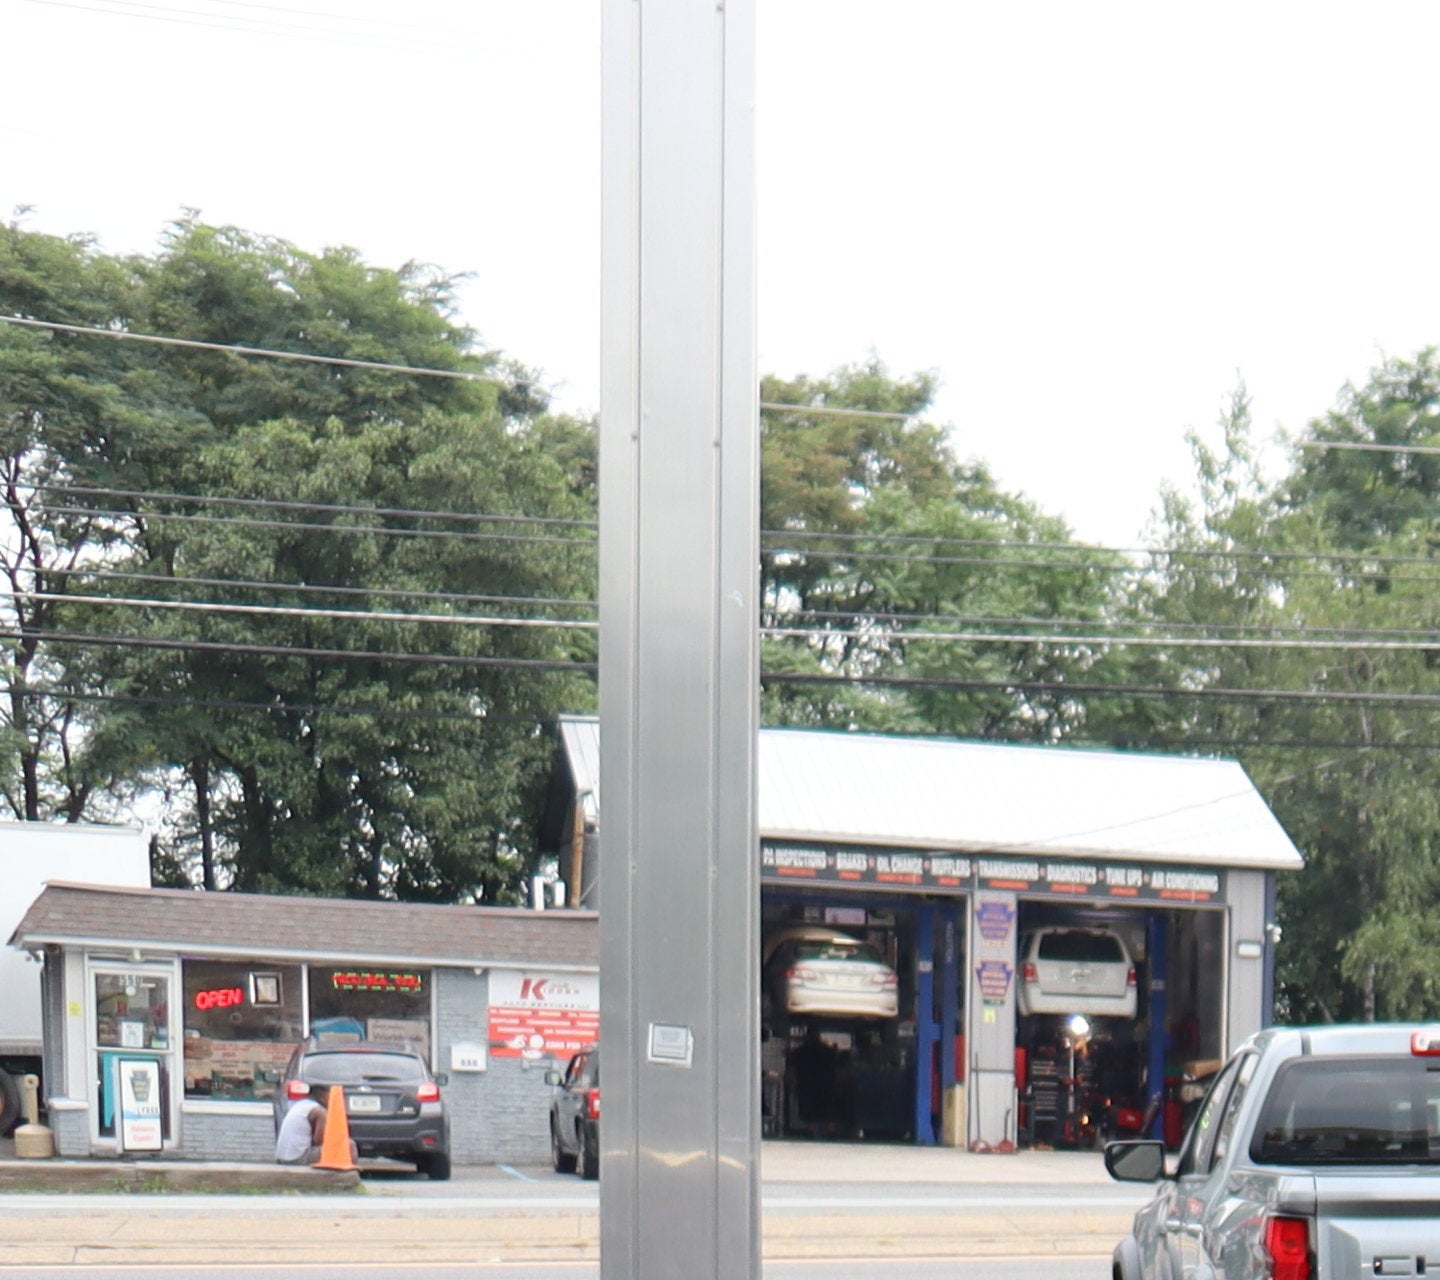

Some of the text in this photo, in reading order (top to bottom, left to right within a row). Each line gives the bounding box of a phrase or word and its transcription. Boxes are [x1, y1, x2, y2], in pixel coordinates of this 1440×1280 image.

[836, 852, 868, 871] BRAKES
[891, 855, 924, 874] CHANGE
[195, 987, 244, 1011] OPEN
